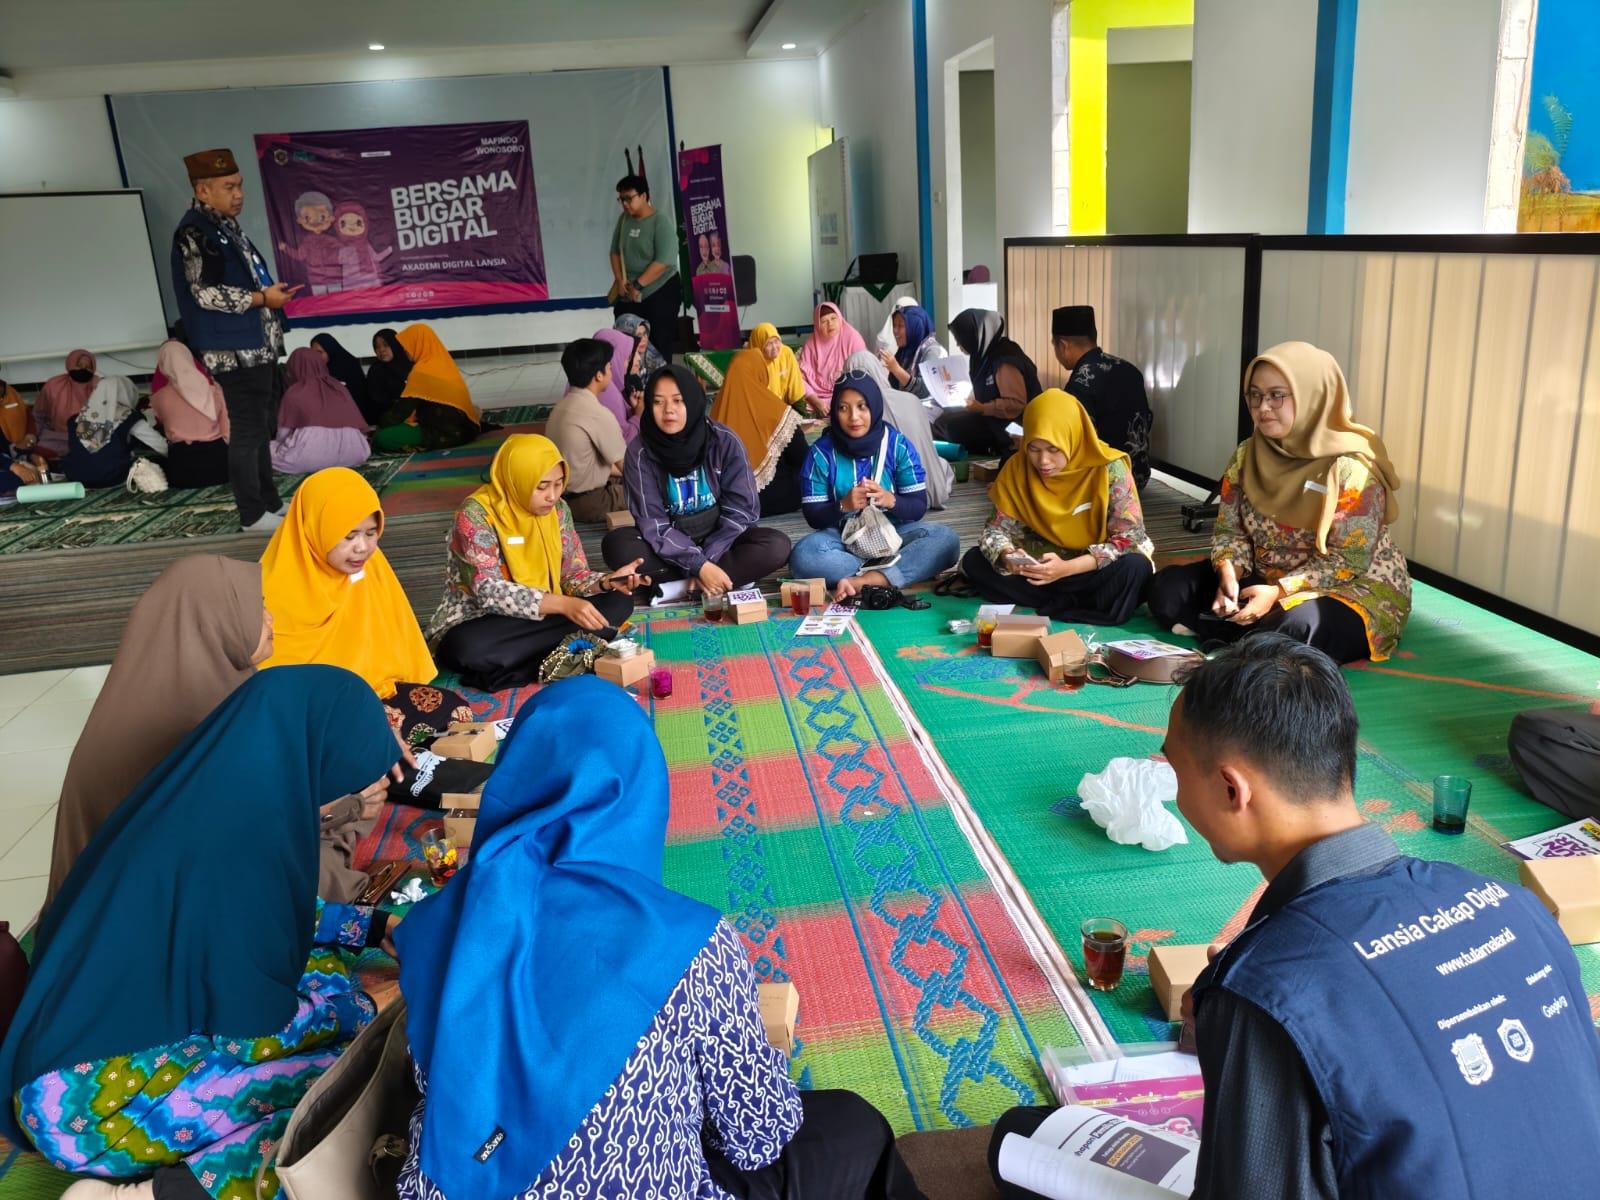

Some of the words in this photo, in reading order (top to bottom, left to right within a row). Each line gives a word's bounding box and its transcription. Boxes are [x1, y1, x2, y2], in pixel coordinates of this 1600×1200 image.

[480, 136, 518, 145] MAFINDO
[475, 144, 525, 155] WONOSOBO
[391, 170, 517, 209] BERSAMA
[394, 196, 485, 230] BUGAR
[690, 197, 721, 216] BERSAMA
[692, 210, 715, 226] BUGAR
[397, 216, 498, 251] DIGITAL
[693, 221, 718, 236] DIGITAL
[402, 261, 441, 271] AKADEMI
[442, 259, 474, 270] DIGITAL
[476, 257, 507, 267] LANSIA
[1353, 922, 1427, 960] Lansia
[1418, 907, 1475, 934] Cakap
[1464, 881, 1510, 909] Digital
